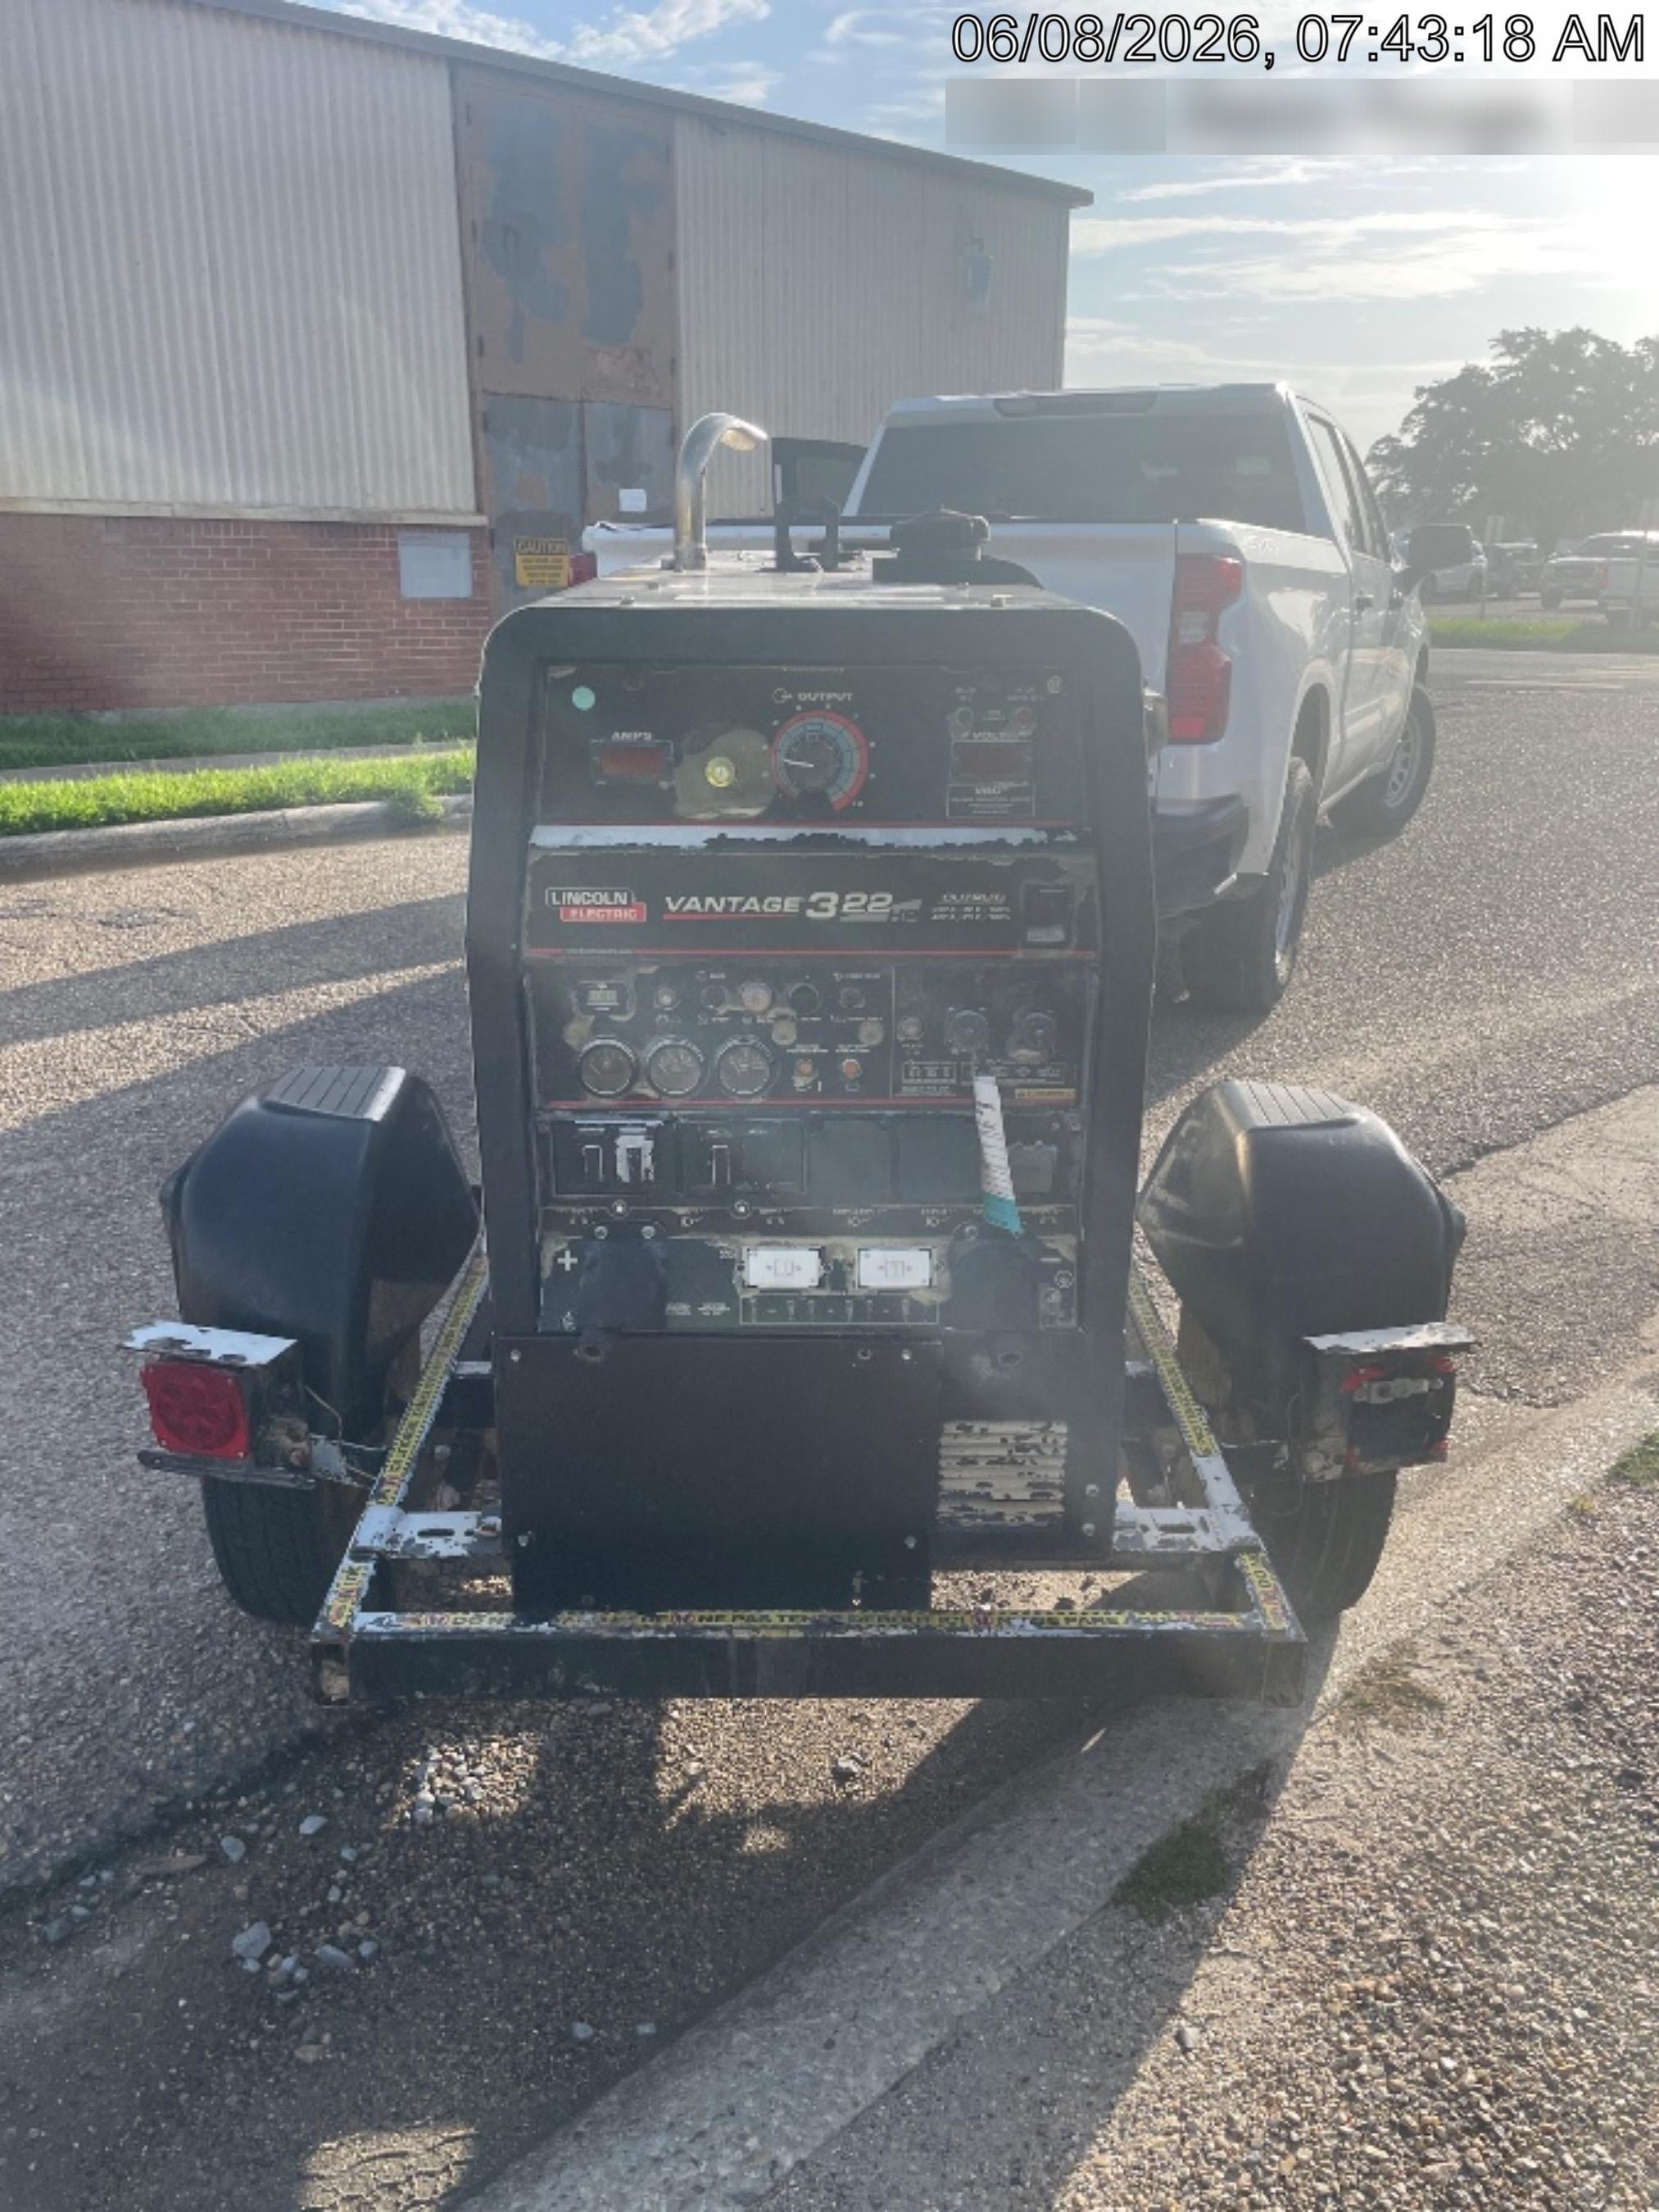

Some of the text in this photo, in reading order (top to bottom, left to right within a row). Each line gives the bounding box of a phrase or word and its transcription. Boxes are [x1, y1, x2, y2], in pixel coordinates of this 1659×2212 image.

[518, 541, 566, 554] CAUTION
[797, 691, 854, 702] OUTPUT
[611, 731, 653, 741] AMPS
[551, 891, 629, 906] LINCOLN
[664, 895, 801, 913] VANTAGE
[805, 891, 894, 919] 322
[569, 907, 638, 920] ELECTRIC
